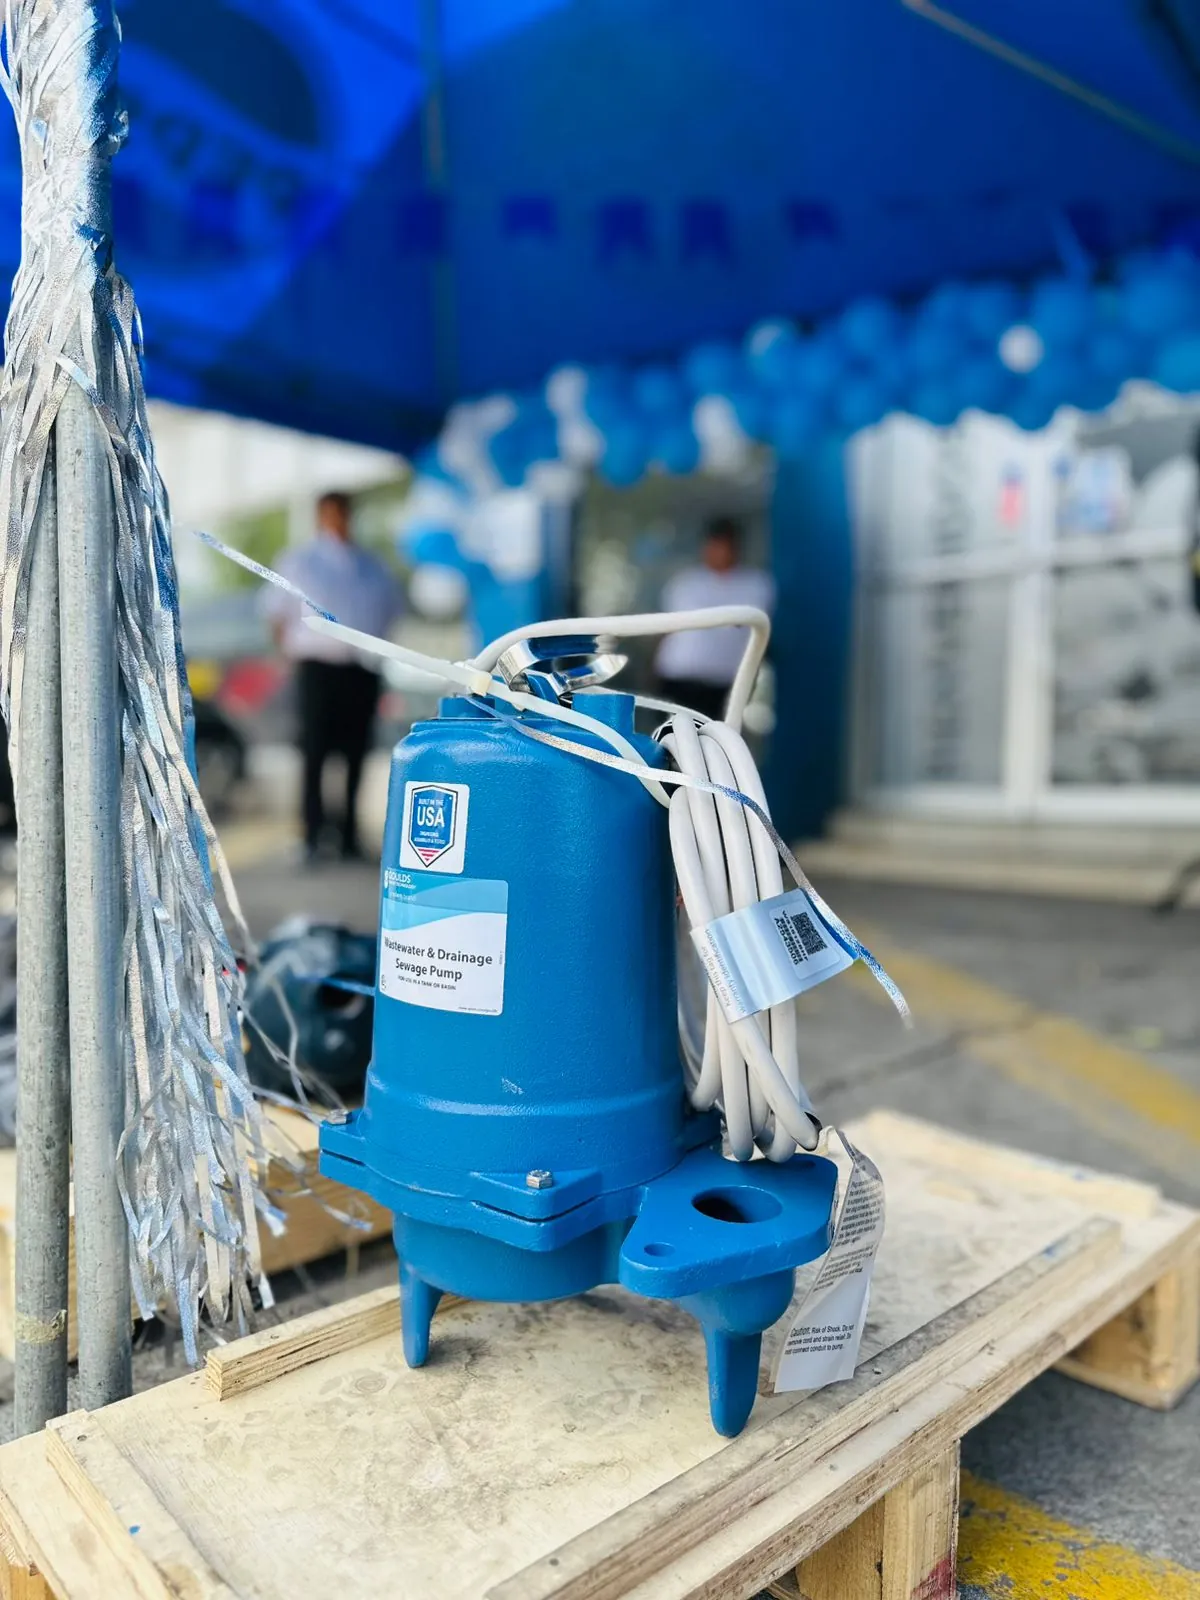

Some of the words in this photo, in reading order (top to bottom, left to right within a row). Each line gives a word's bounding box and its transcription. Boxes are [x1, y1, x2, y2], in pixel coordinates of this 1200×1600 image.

[416, 806, 446, 828] USA
[384, 936, 426, 957] Wastewater
[426, 947, 436, 959] &
[437, 948, 493, 967] Drainage
[395, 957, 428, 977] Sewage
[429, 965, 463, 983] Pump
